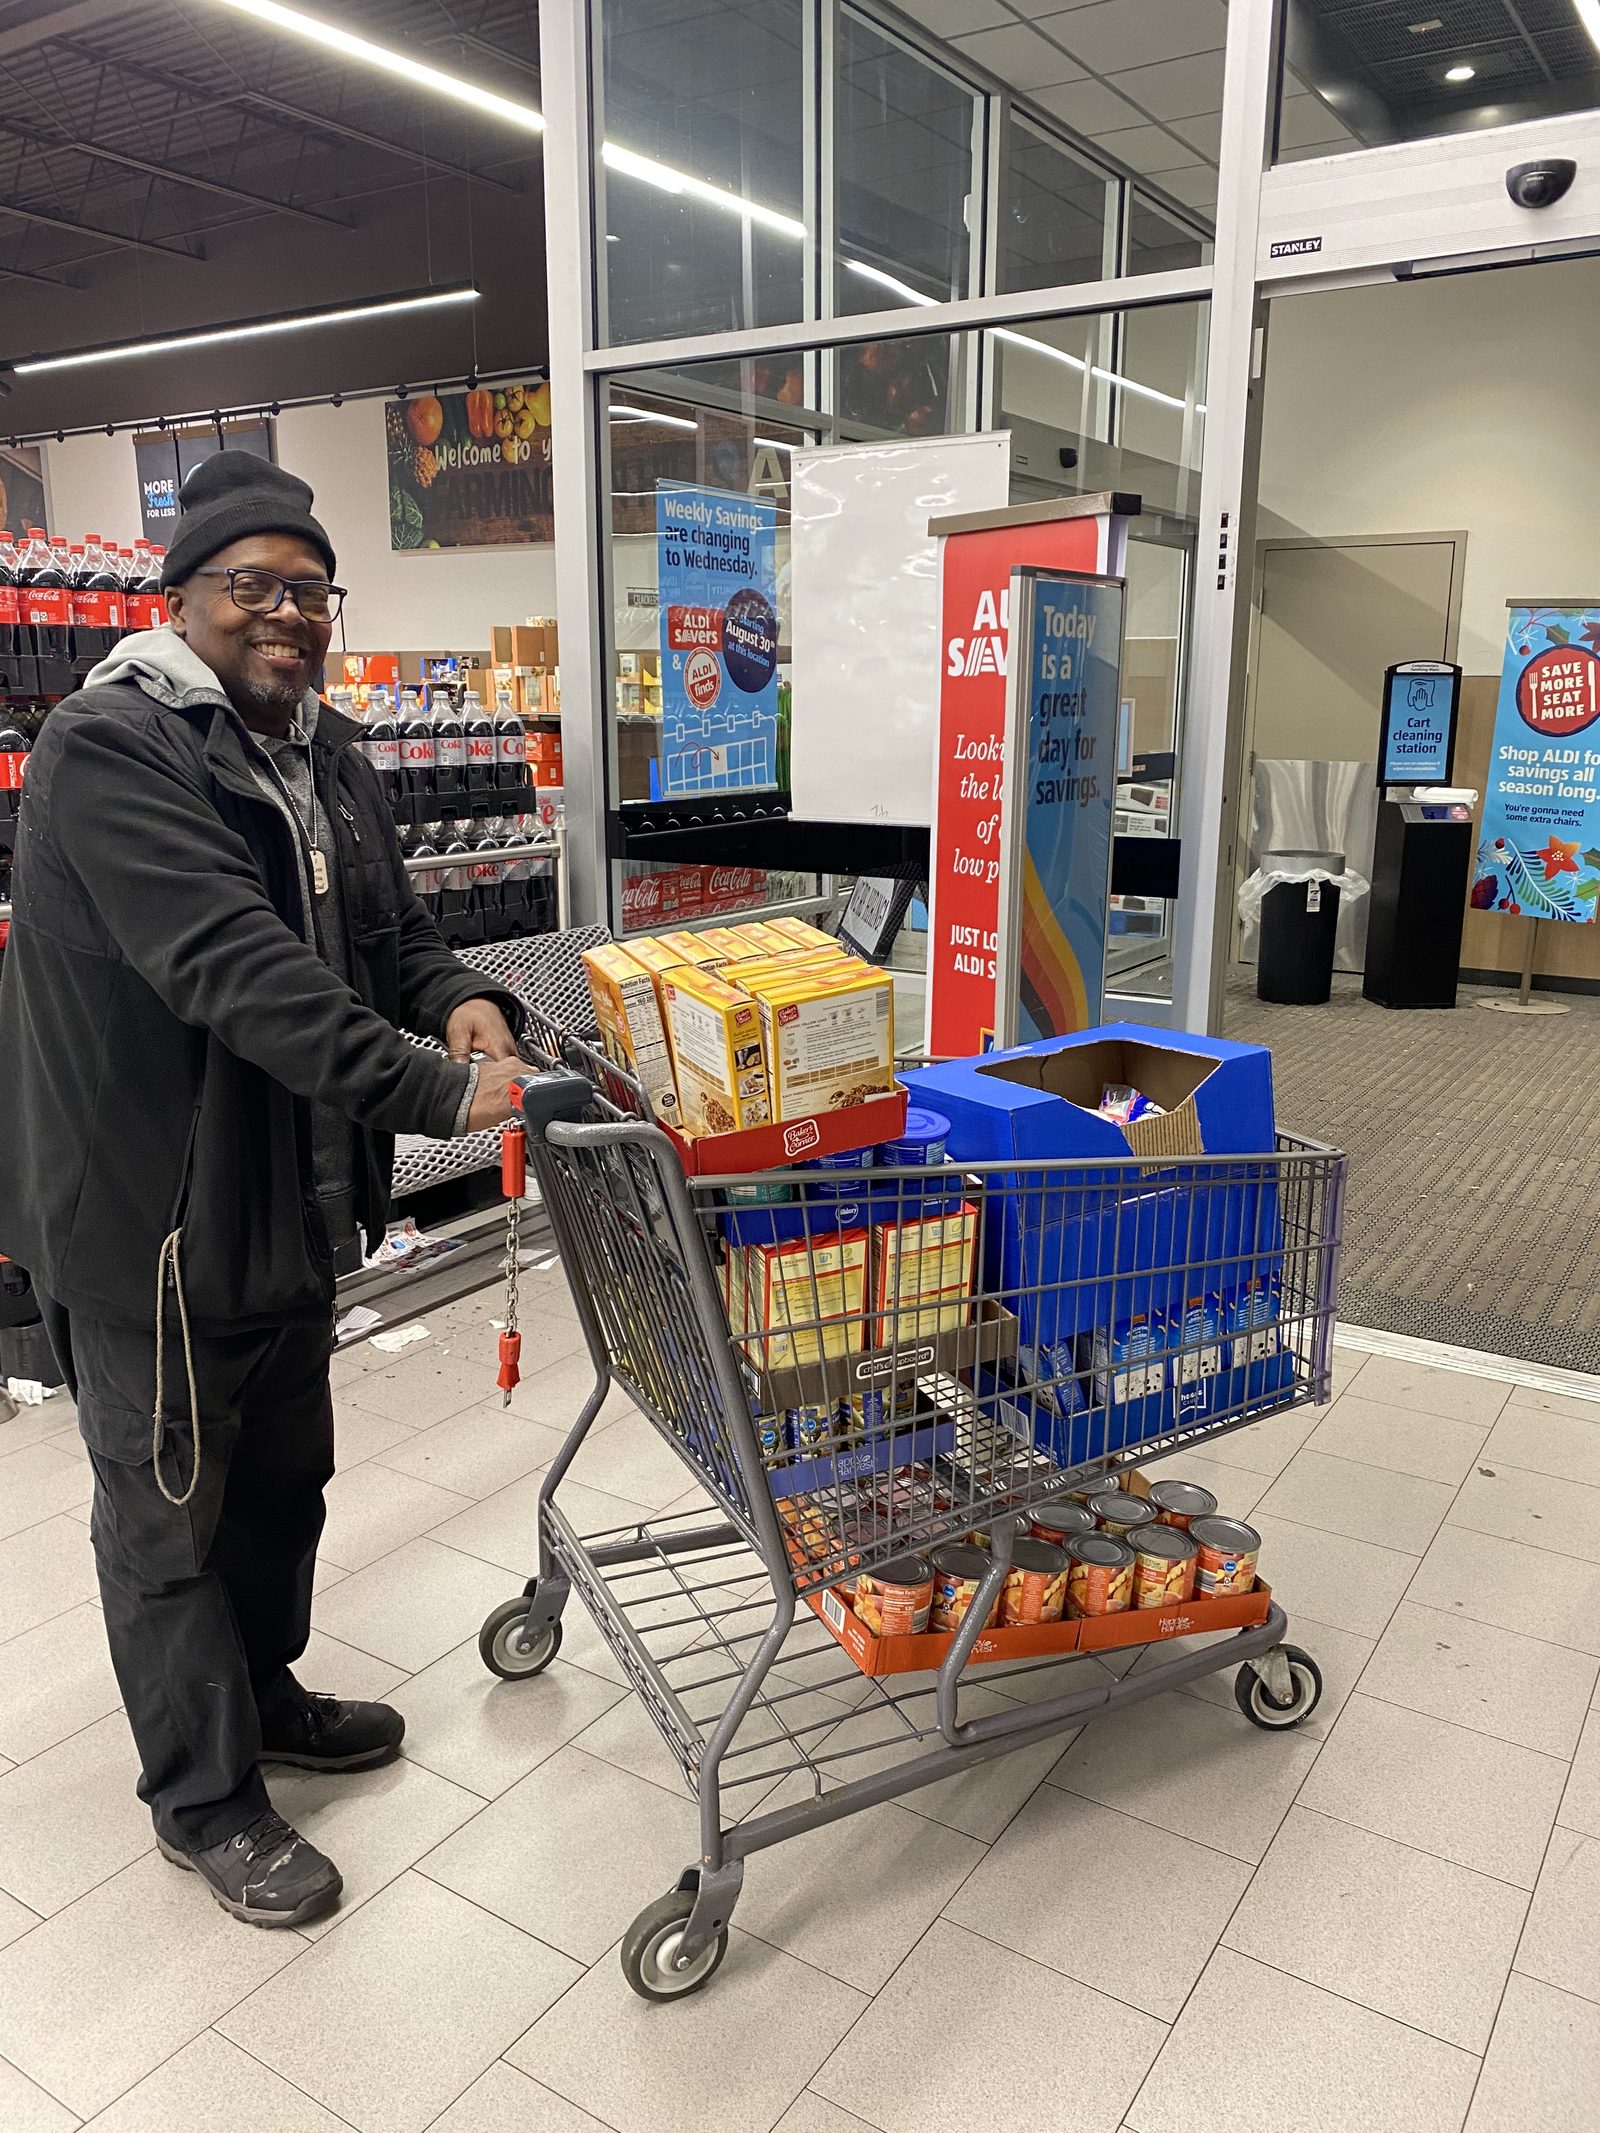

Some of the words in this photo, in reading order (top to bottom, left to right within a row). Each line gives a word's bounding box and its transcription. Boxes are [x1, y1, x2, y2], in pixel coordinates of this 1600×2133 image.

[1271, 239, 1320, 255] STANLEY
[435, 442, 501, 471] Welcome
[511, 436, 531, 464] to
[143, 480, 174, 495] MORE
[147, 492, 175, 508] Fresh
[147, 509, 160, 518] FOR
[160, 508, 176, 517] LESS
[664, 498, 712, 528] Weekly
[715, 505, 763, 534] Savings
[665, 525, 688, 543] are
[691, 526, 750, 556] changing
[666, 547, 680, 567] to
[684, 549, 758, 579] Wednesday.
[28, 589, 60, 602] Coca-Cola
[683, 615, 710, 629] ALDI
[739, 615, 765, 634] Starting
[1043, 604, 1097, 648] Today
[726, 620, 759, 647] August
[672, 654, 682, 670] &
[727, 641, 736, 651] at
[736, 644, 747, 656] this
[747, 649, 770, 668] location
[1041, 643, 1055, 680] is
[1060, 653, 1072, 680] a
[692, 664, 712, 680] ALDI
[1541, 662, 1582, 678] SAVE
[694, 680, 715, 697] finds
[1540, 676, 1584, 693] MORE
[1543, 690, 1582, 706] SEAT
[1039, 688, 1087, 726] great
[1540, 704, 1585, 721] MORE
[1407, 717, 1430, 728] Cart
[440, 739, 463, 749] Coke
[1393, 730, 1443, 744] cleaning
[1038, 730, 1072, 771] day
[1074, 728, 1096, 761] for
[1396, 742, 1437, 754] station
[1498, 746, 1538, 764] Shop
[1542, 749, 1580, 764] ALDI
[1507, 764, 1569, 784] savings
[1573, 767, 1595, 783] all
[960, 773, 989, 800] the
[1035, 769, 1100, 808] savings.
[1498, 781, 1554, 796] season
[1557, 783, 1600, 803] long.
[1504, 803, 1530, 814] You're
[1531, 806, 1560, 817] gonna
[1562, 807, 1585, 818] need
[1505, 813, 1528, 822] some
[1529, 815, 1552, 824] extra
[1553, 816, 1583, 828] chairs.
[977, 814, 998, 845] of
[953, 848, 985, 875] low
[709, 867, 752, 895] Coca-Cola
[950, 924, 980, 949] JUST
[954, 952, 985, 977] ALDI
[787, 1124, 814, 1141] Baker's
[789, 1136, 816, 1152] Corner
